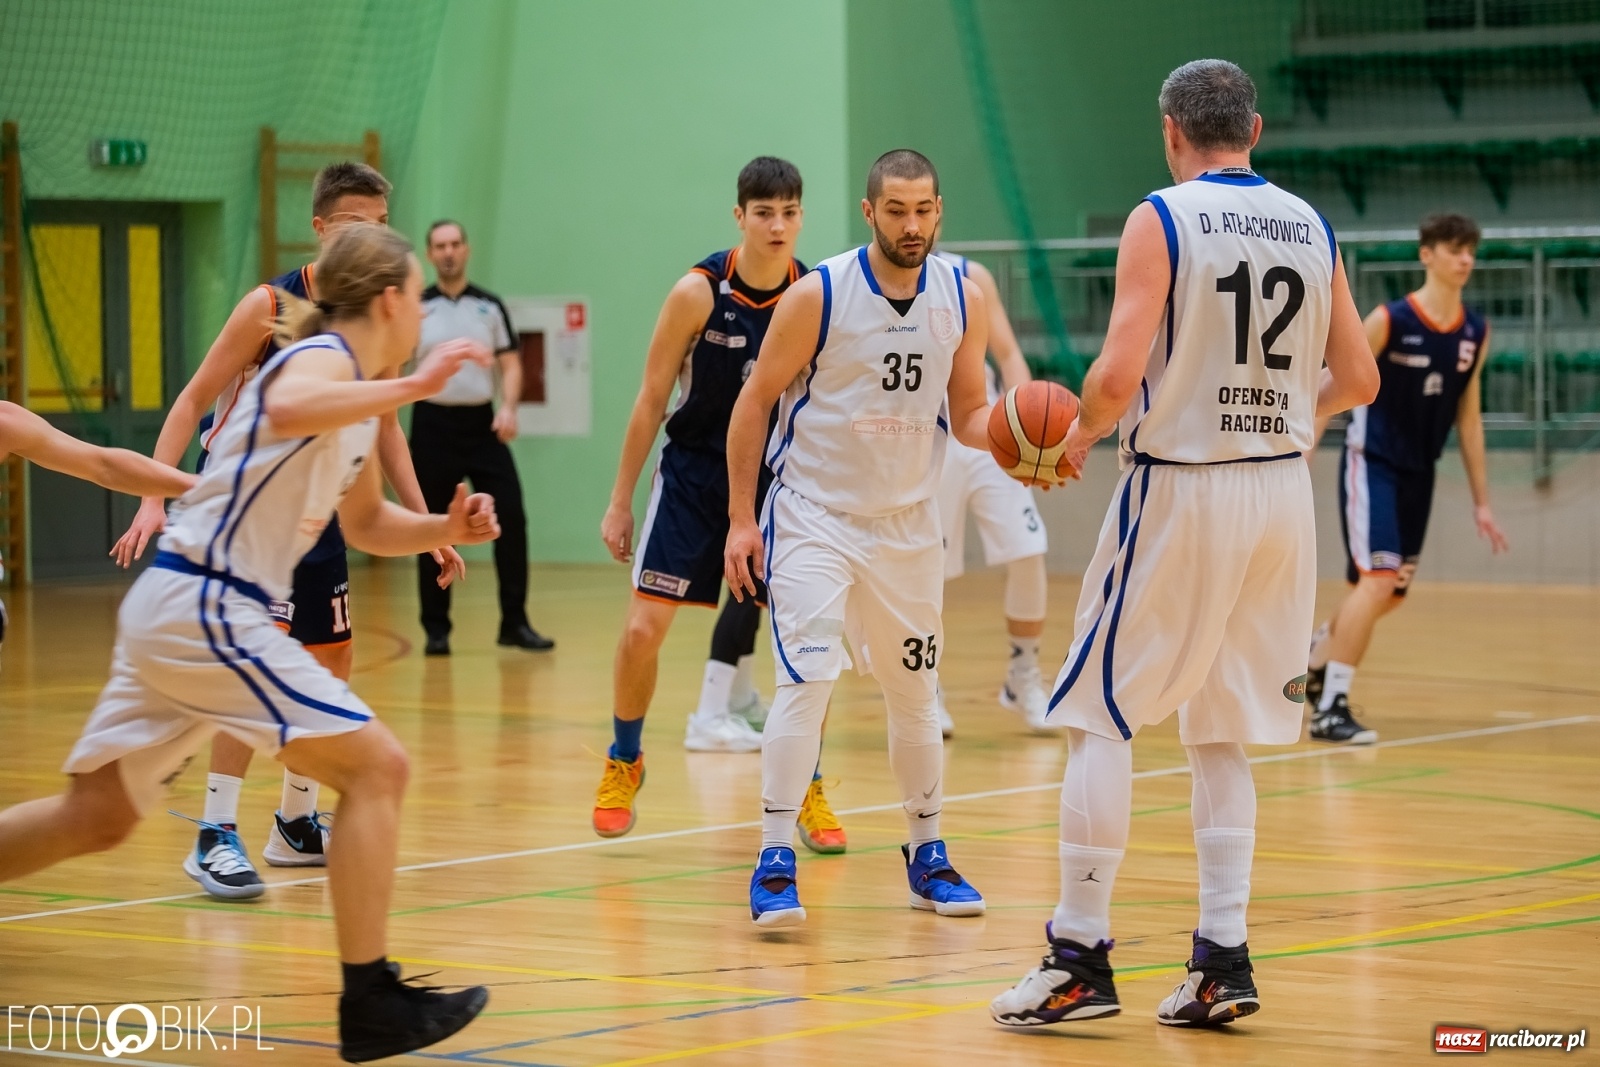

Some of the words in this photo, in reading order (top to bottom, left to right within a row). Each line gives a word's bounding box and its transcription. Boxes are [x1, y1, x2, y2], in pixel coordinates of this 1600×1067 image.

[1199, 212, 1218, 235] D.
[1222, 211, 1312, 246] ATŁACHOWICZ
[1216, 260, 1306, 371] 12
[882, 352, 924, 392] 35
[902, 634, 937, 671] 35
